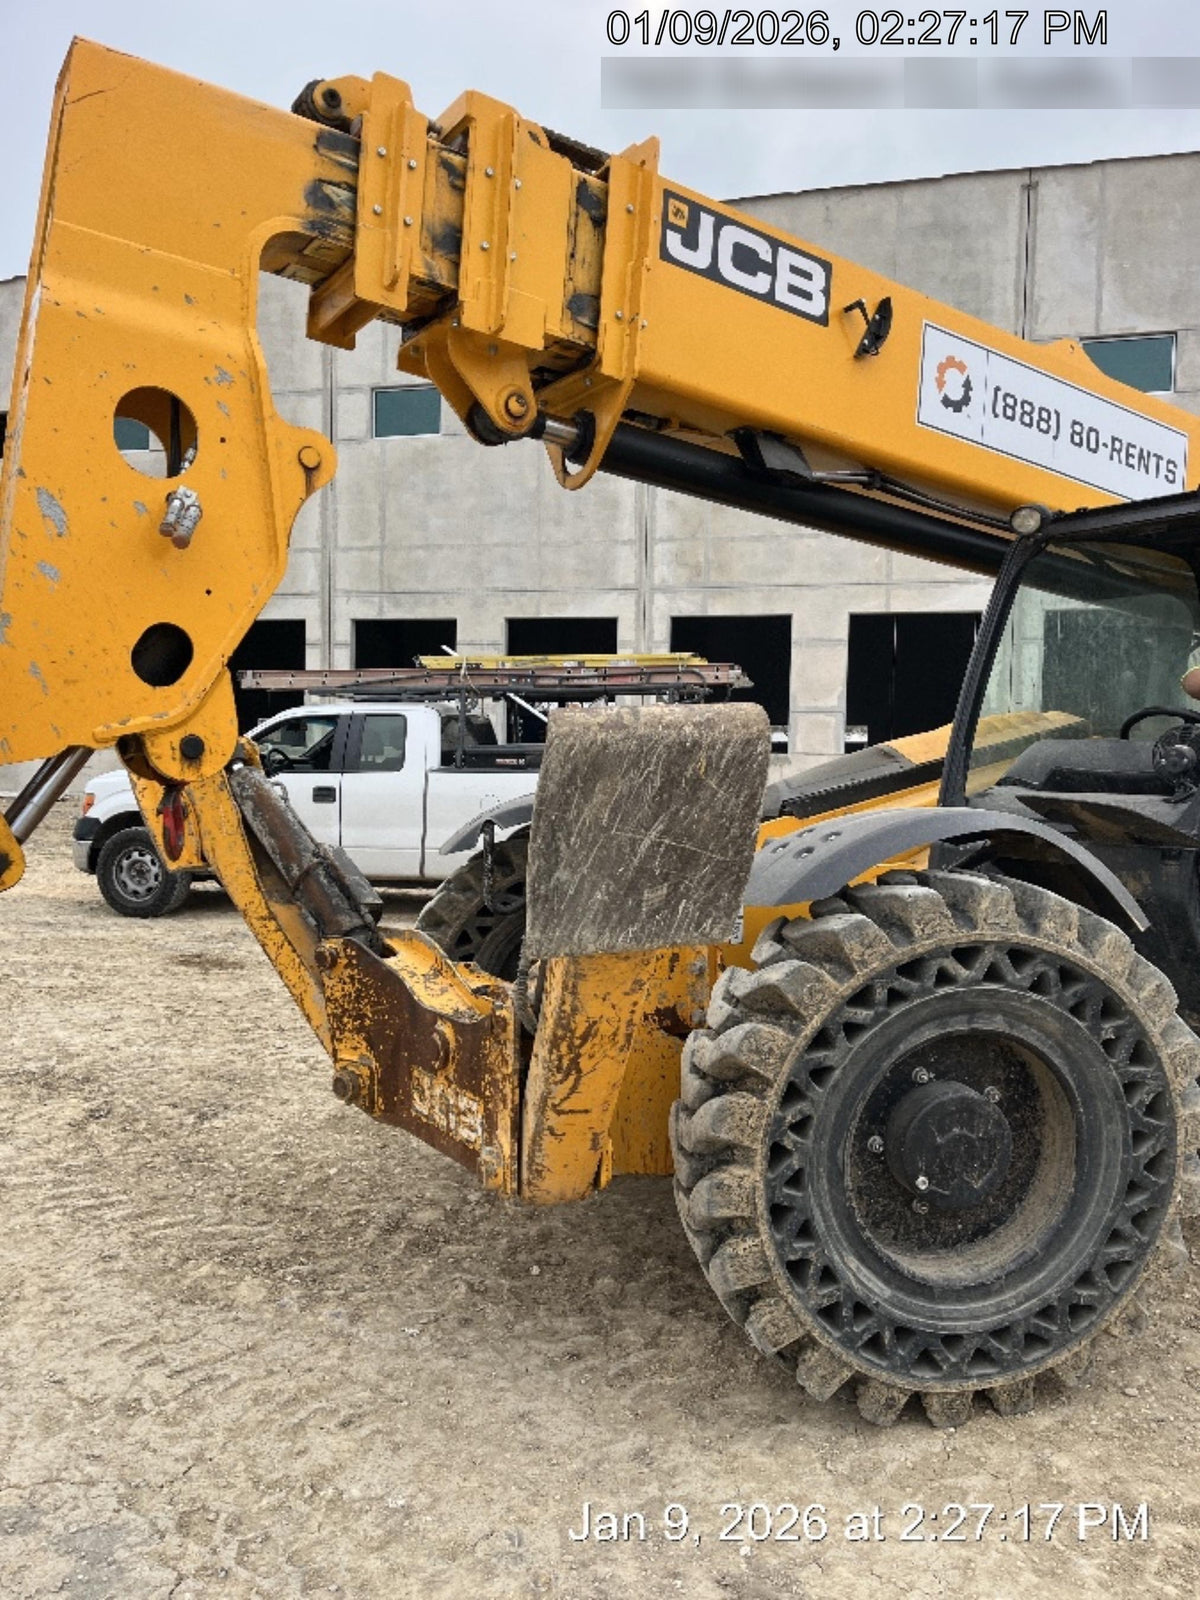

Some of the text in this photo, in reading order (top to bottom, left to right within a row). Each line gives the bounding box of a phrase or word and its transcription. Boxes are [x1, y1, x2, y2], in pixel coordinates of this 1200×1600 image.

[666, 210, 827, 318] JCB
[991, 385, 1178, 485] (888) 80-RENTS
